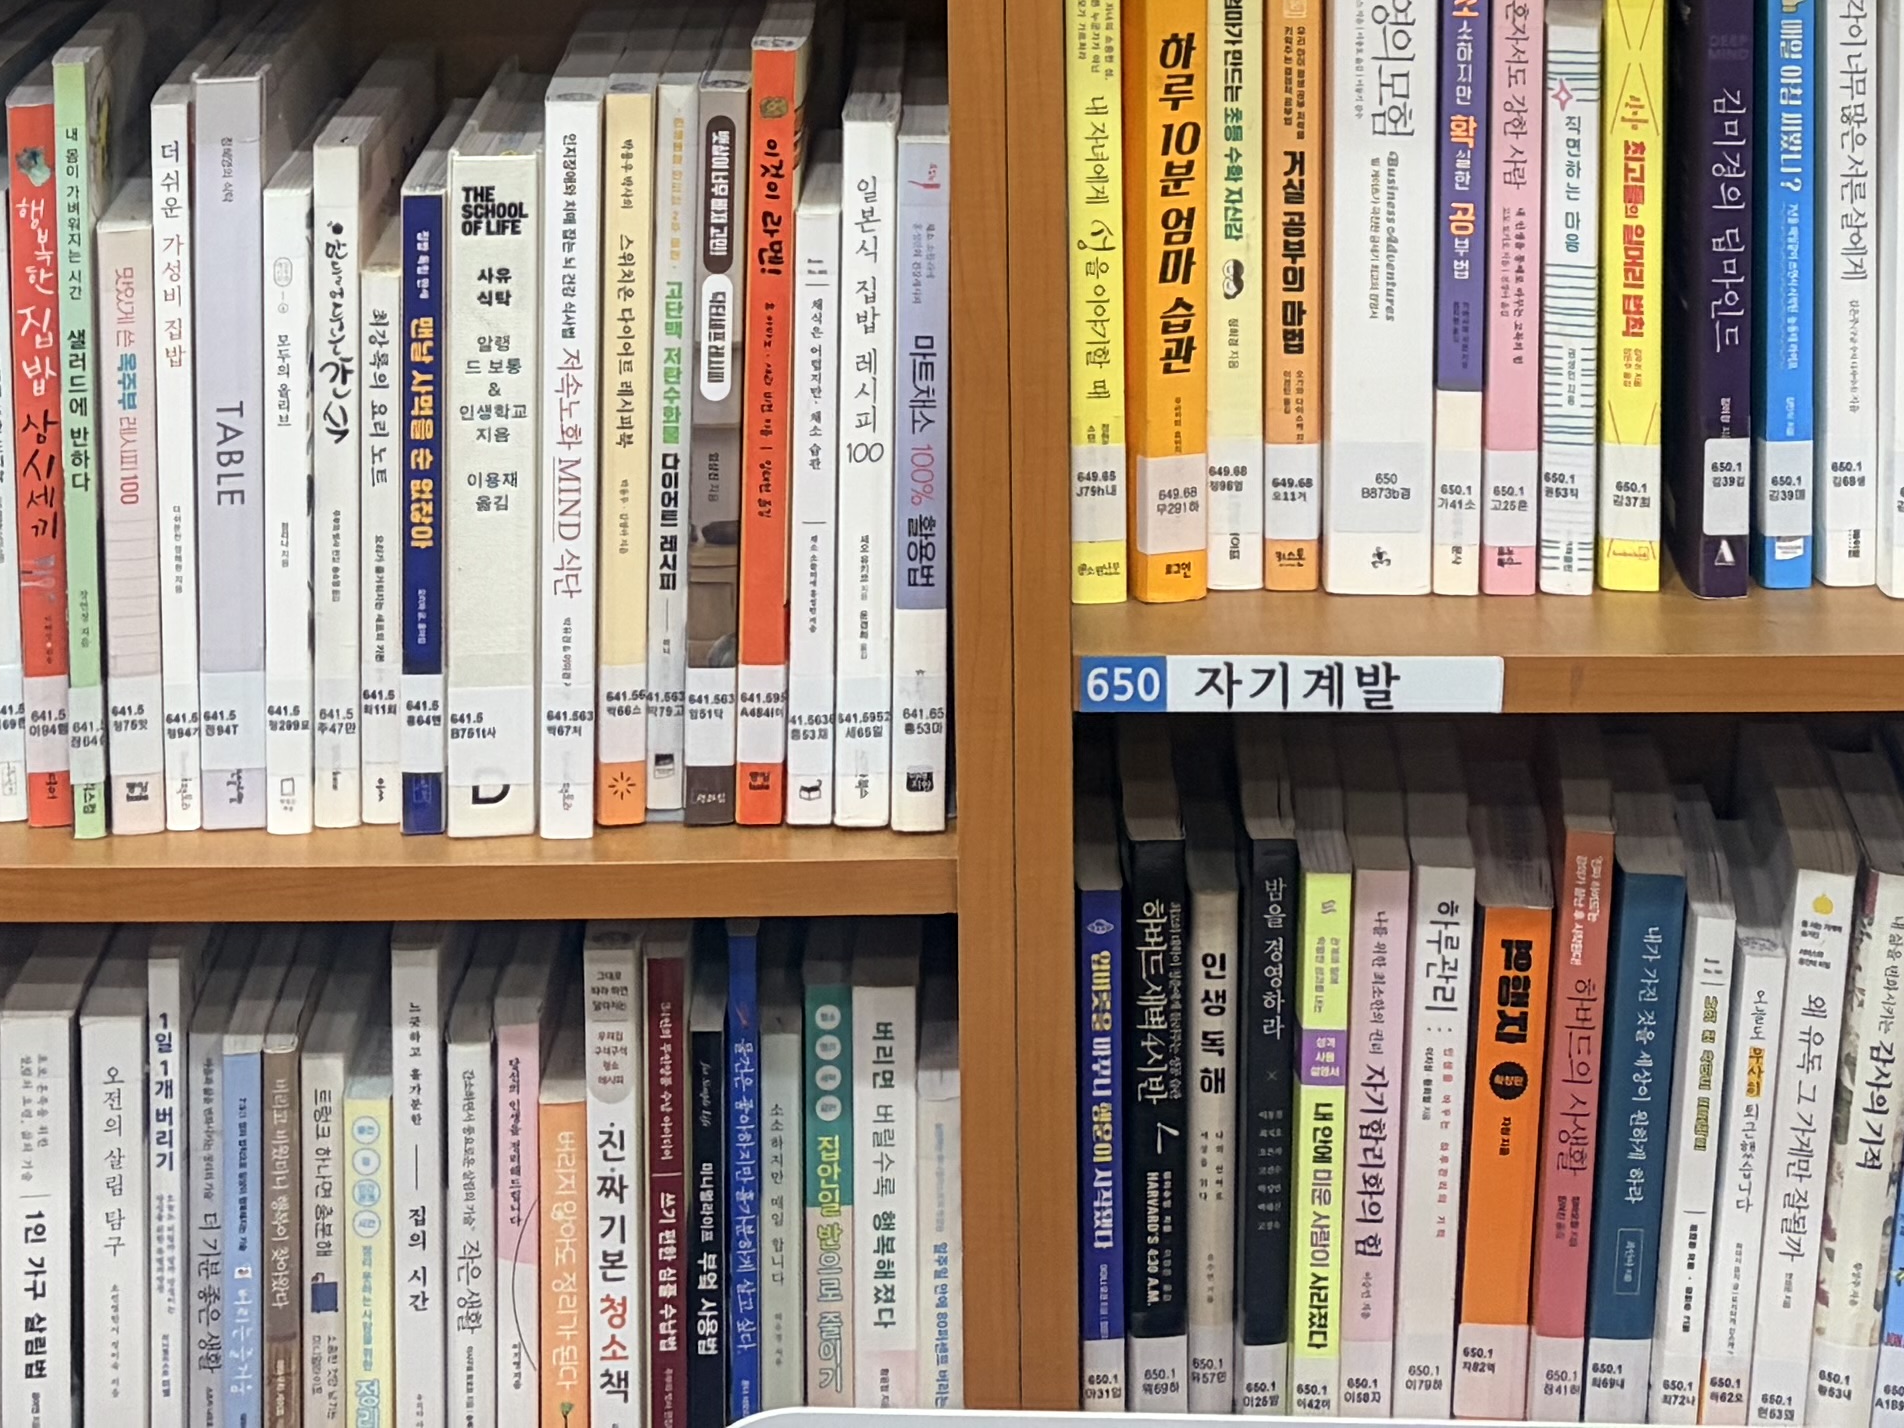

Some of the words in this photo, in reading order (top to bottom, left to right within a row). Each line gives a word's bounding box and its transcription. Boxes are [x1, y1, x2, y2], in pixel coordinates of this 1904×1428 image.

[462, 186, 495, 203] THE
[460, 202, 529, 219] SCHOOL
[460, 219, 480, 235] OF
[484, 219, 522, 235] LIFE
[216, 401, 244, 505] TABLE
[1375, 474, 1398, 484] 650
[1088, 667, 1160, 701] 650
[1195, 662, 1400, 710] 자기계발
